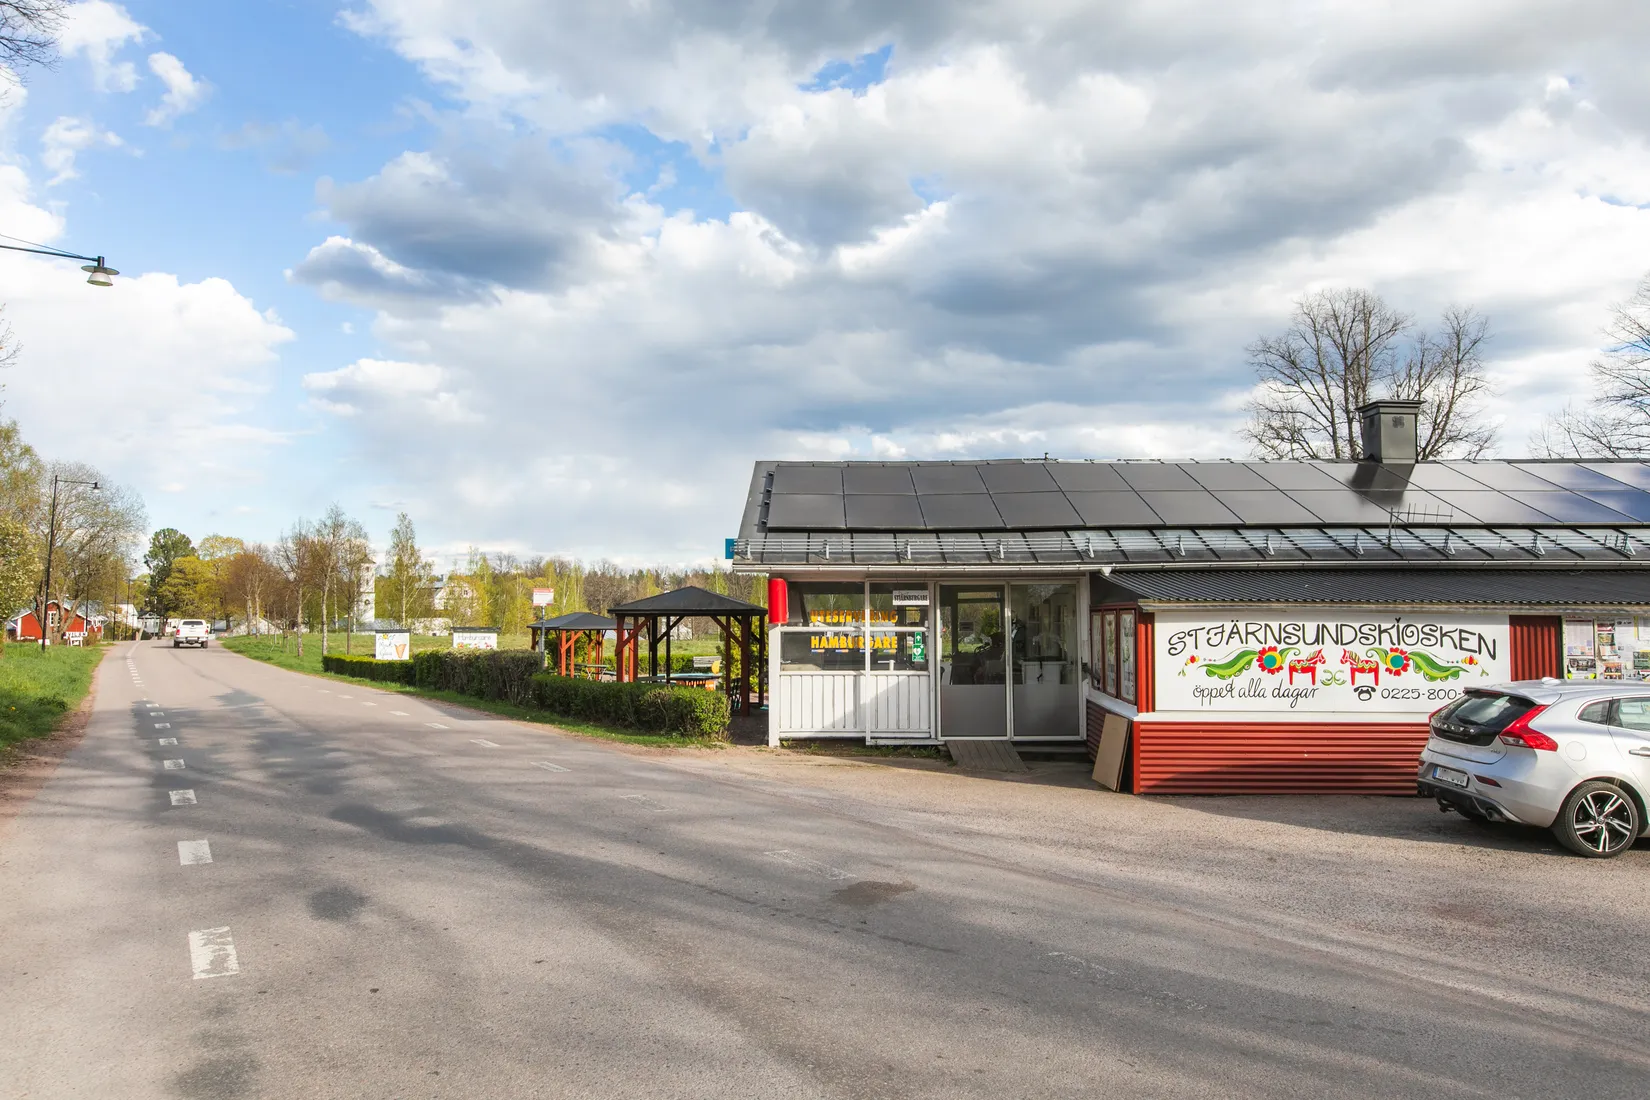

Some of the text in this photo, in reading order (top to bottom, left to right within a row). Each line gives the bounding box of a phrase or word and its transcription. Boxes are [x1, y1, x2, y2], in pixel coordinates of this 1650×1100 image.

[811, 636, 898, 649] HAMBURGARE
[1168, 617, 1497, 660] STJÄRNSUNDSKIOSKEN
[1193, 677, 1319, 708] öppet alla dagar
